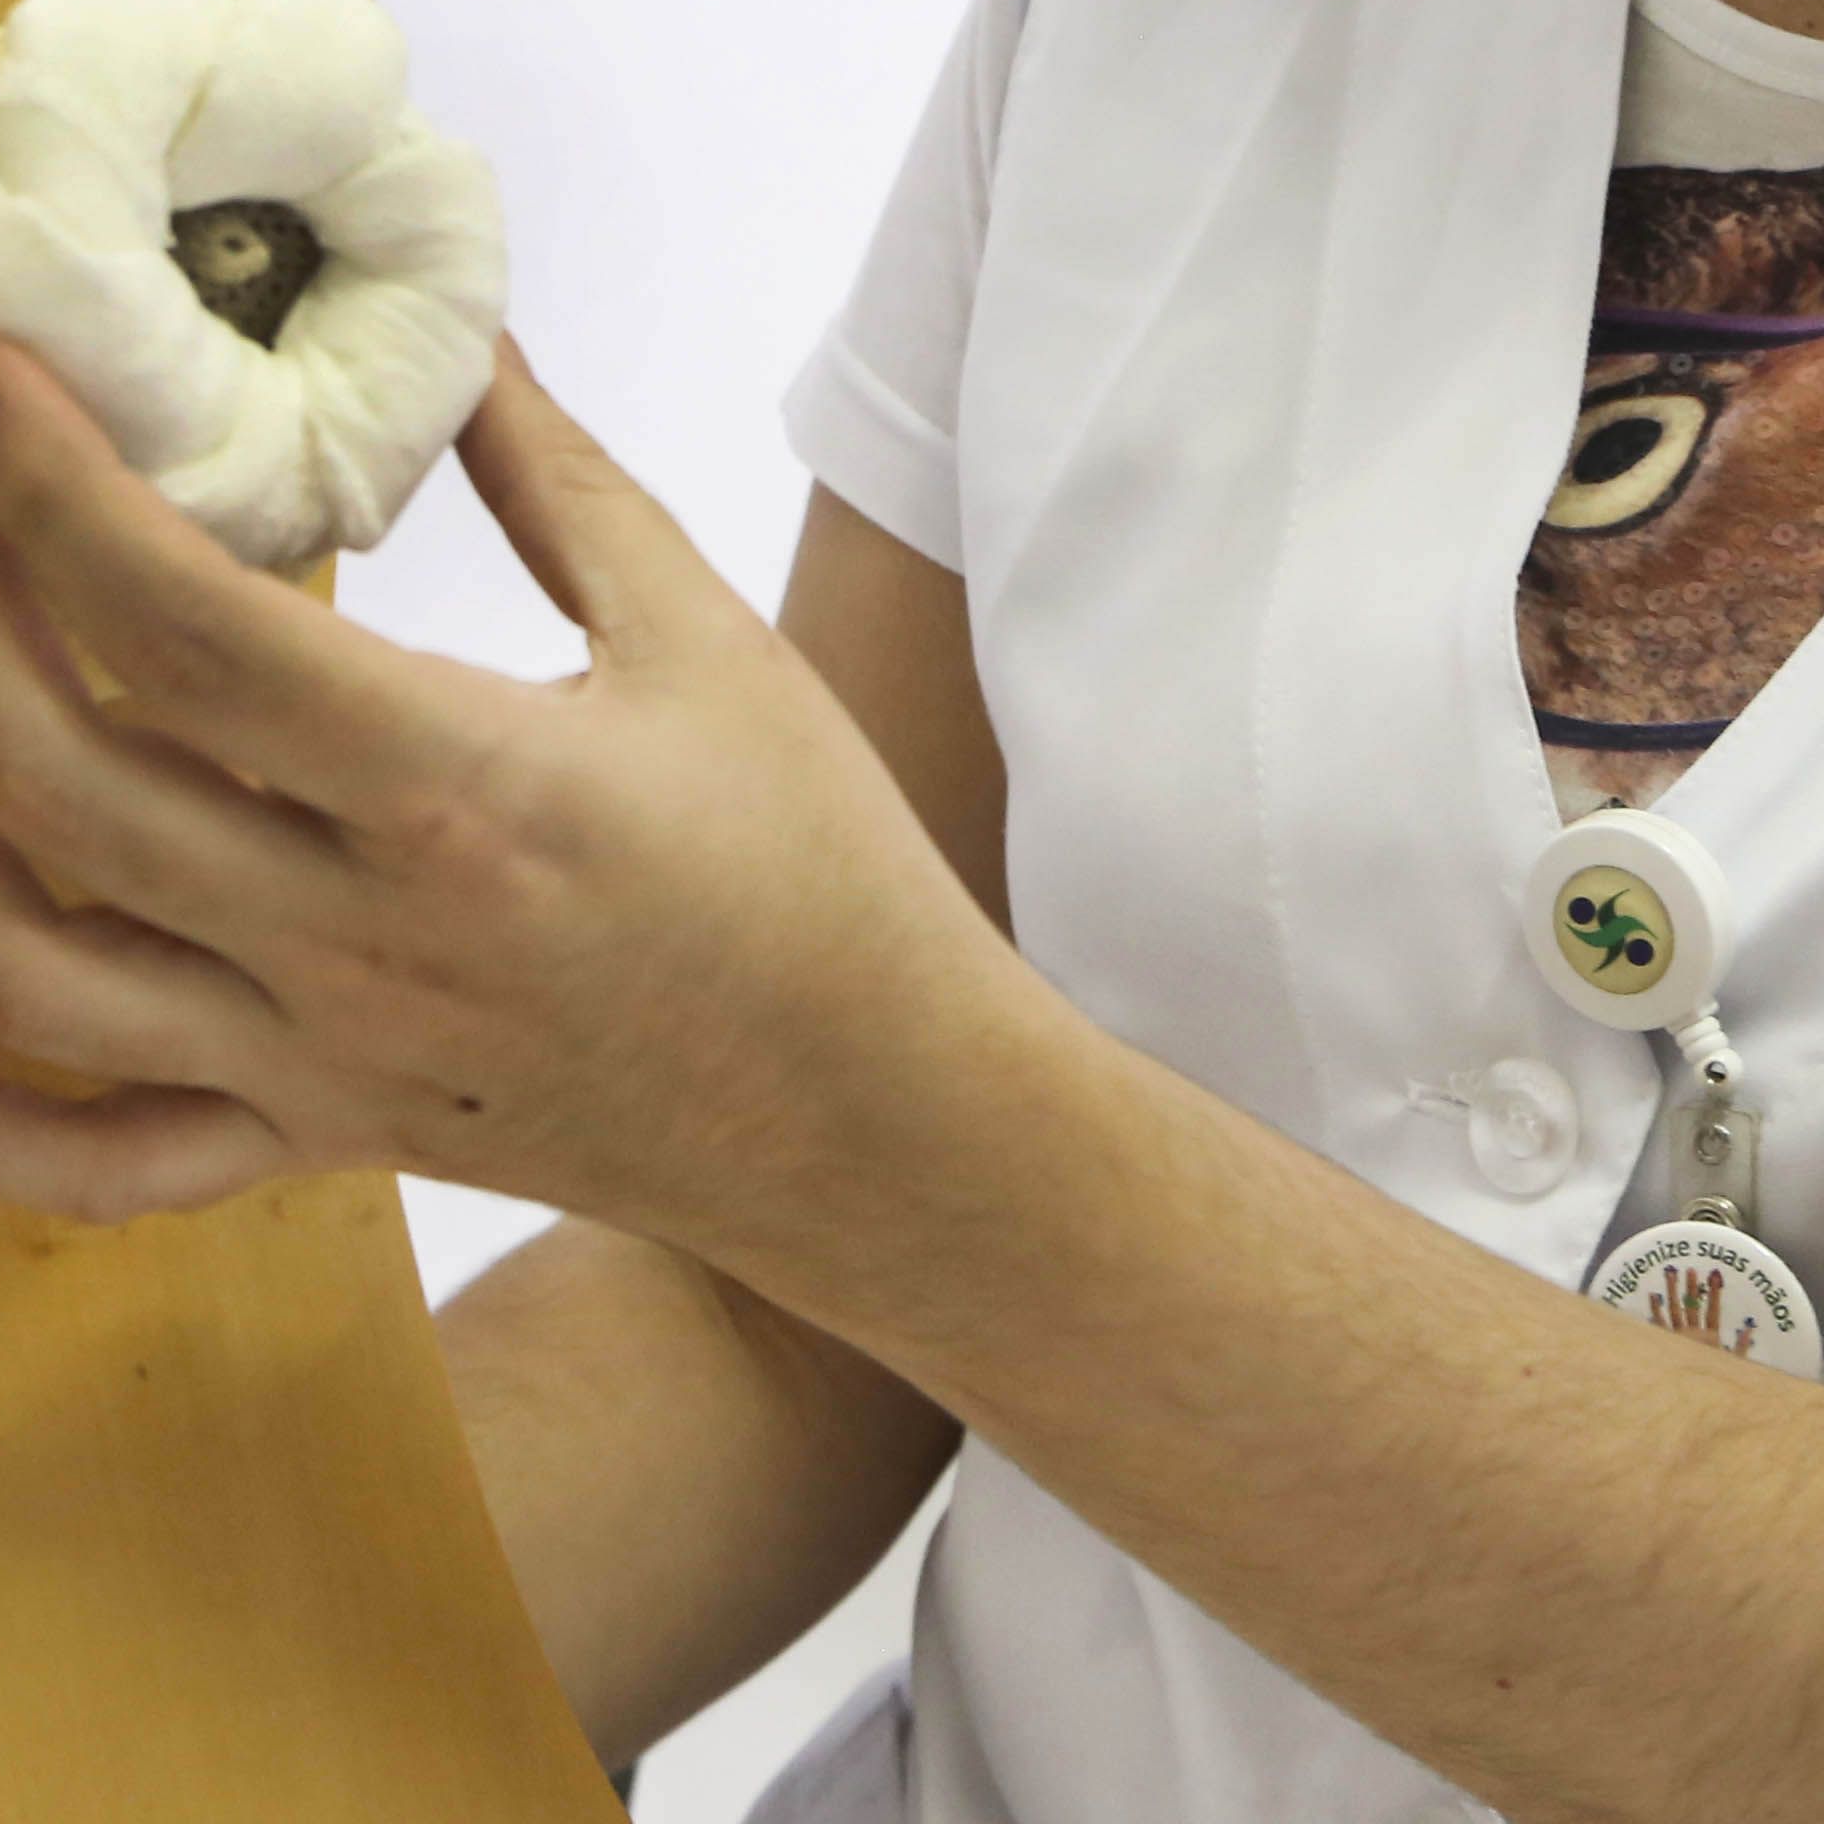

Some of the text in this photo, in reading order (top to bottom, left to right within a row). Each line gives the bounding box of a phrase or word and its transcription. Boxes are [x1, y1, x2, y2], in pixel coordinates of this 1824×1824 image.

[1602, 1240, 1796, 1333] Higienize suas mãos
